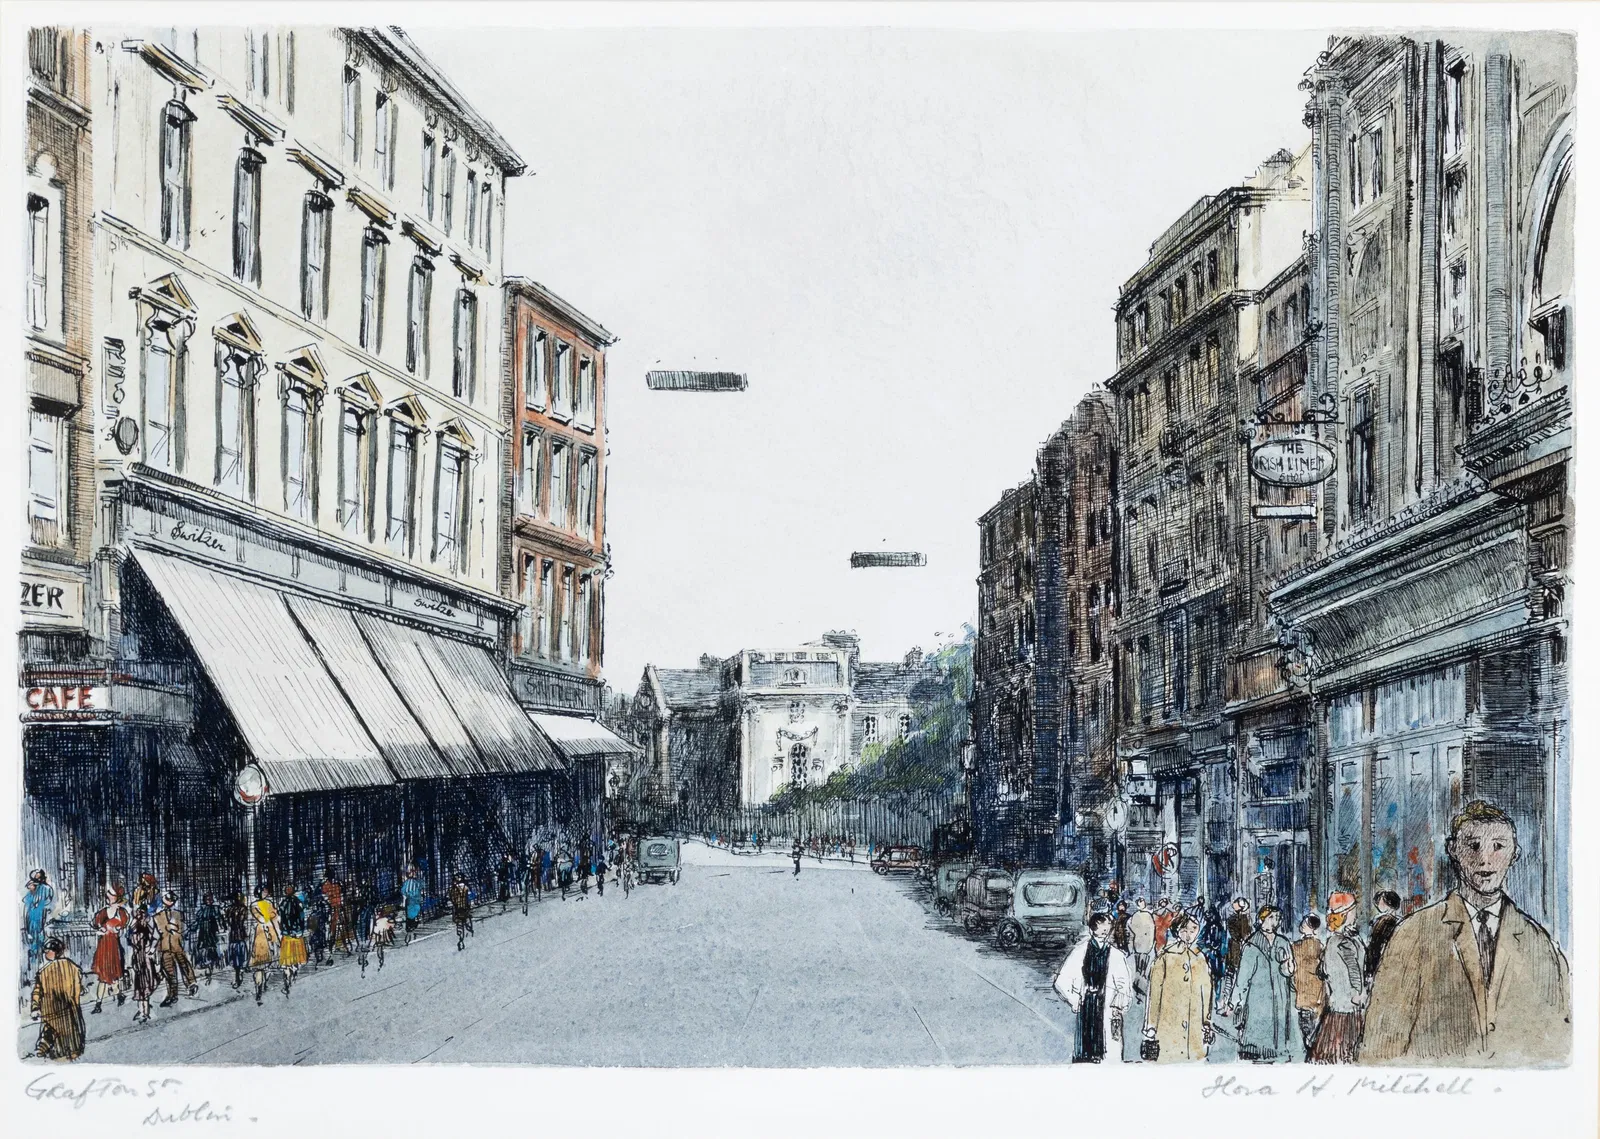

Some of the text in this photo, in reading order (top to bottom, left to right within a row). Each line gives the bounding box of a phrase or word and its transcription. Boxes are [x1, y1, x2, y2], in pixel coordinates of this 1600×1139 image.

[1281, 443, 1304, 454] THE
[1254, 455, 1325, 472] IRISH LINEN
[20, 581, 64, 610] ZER
